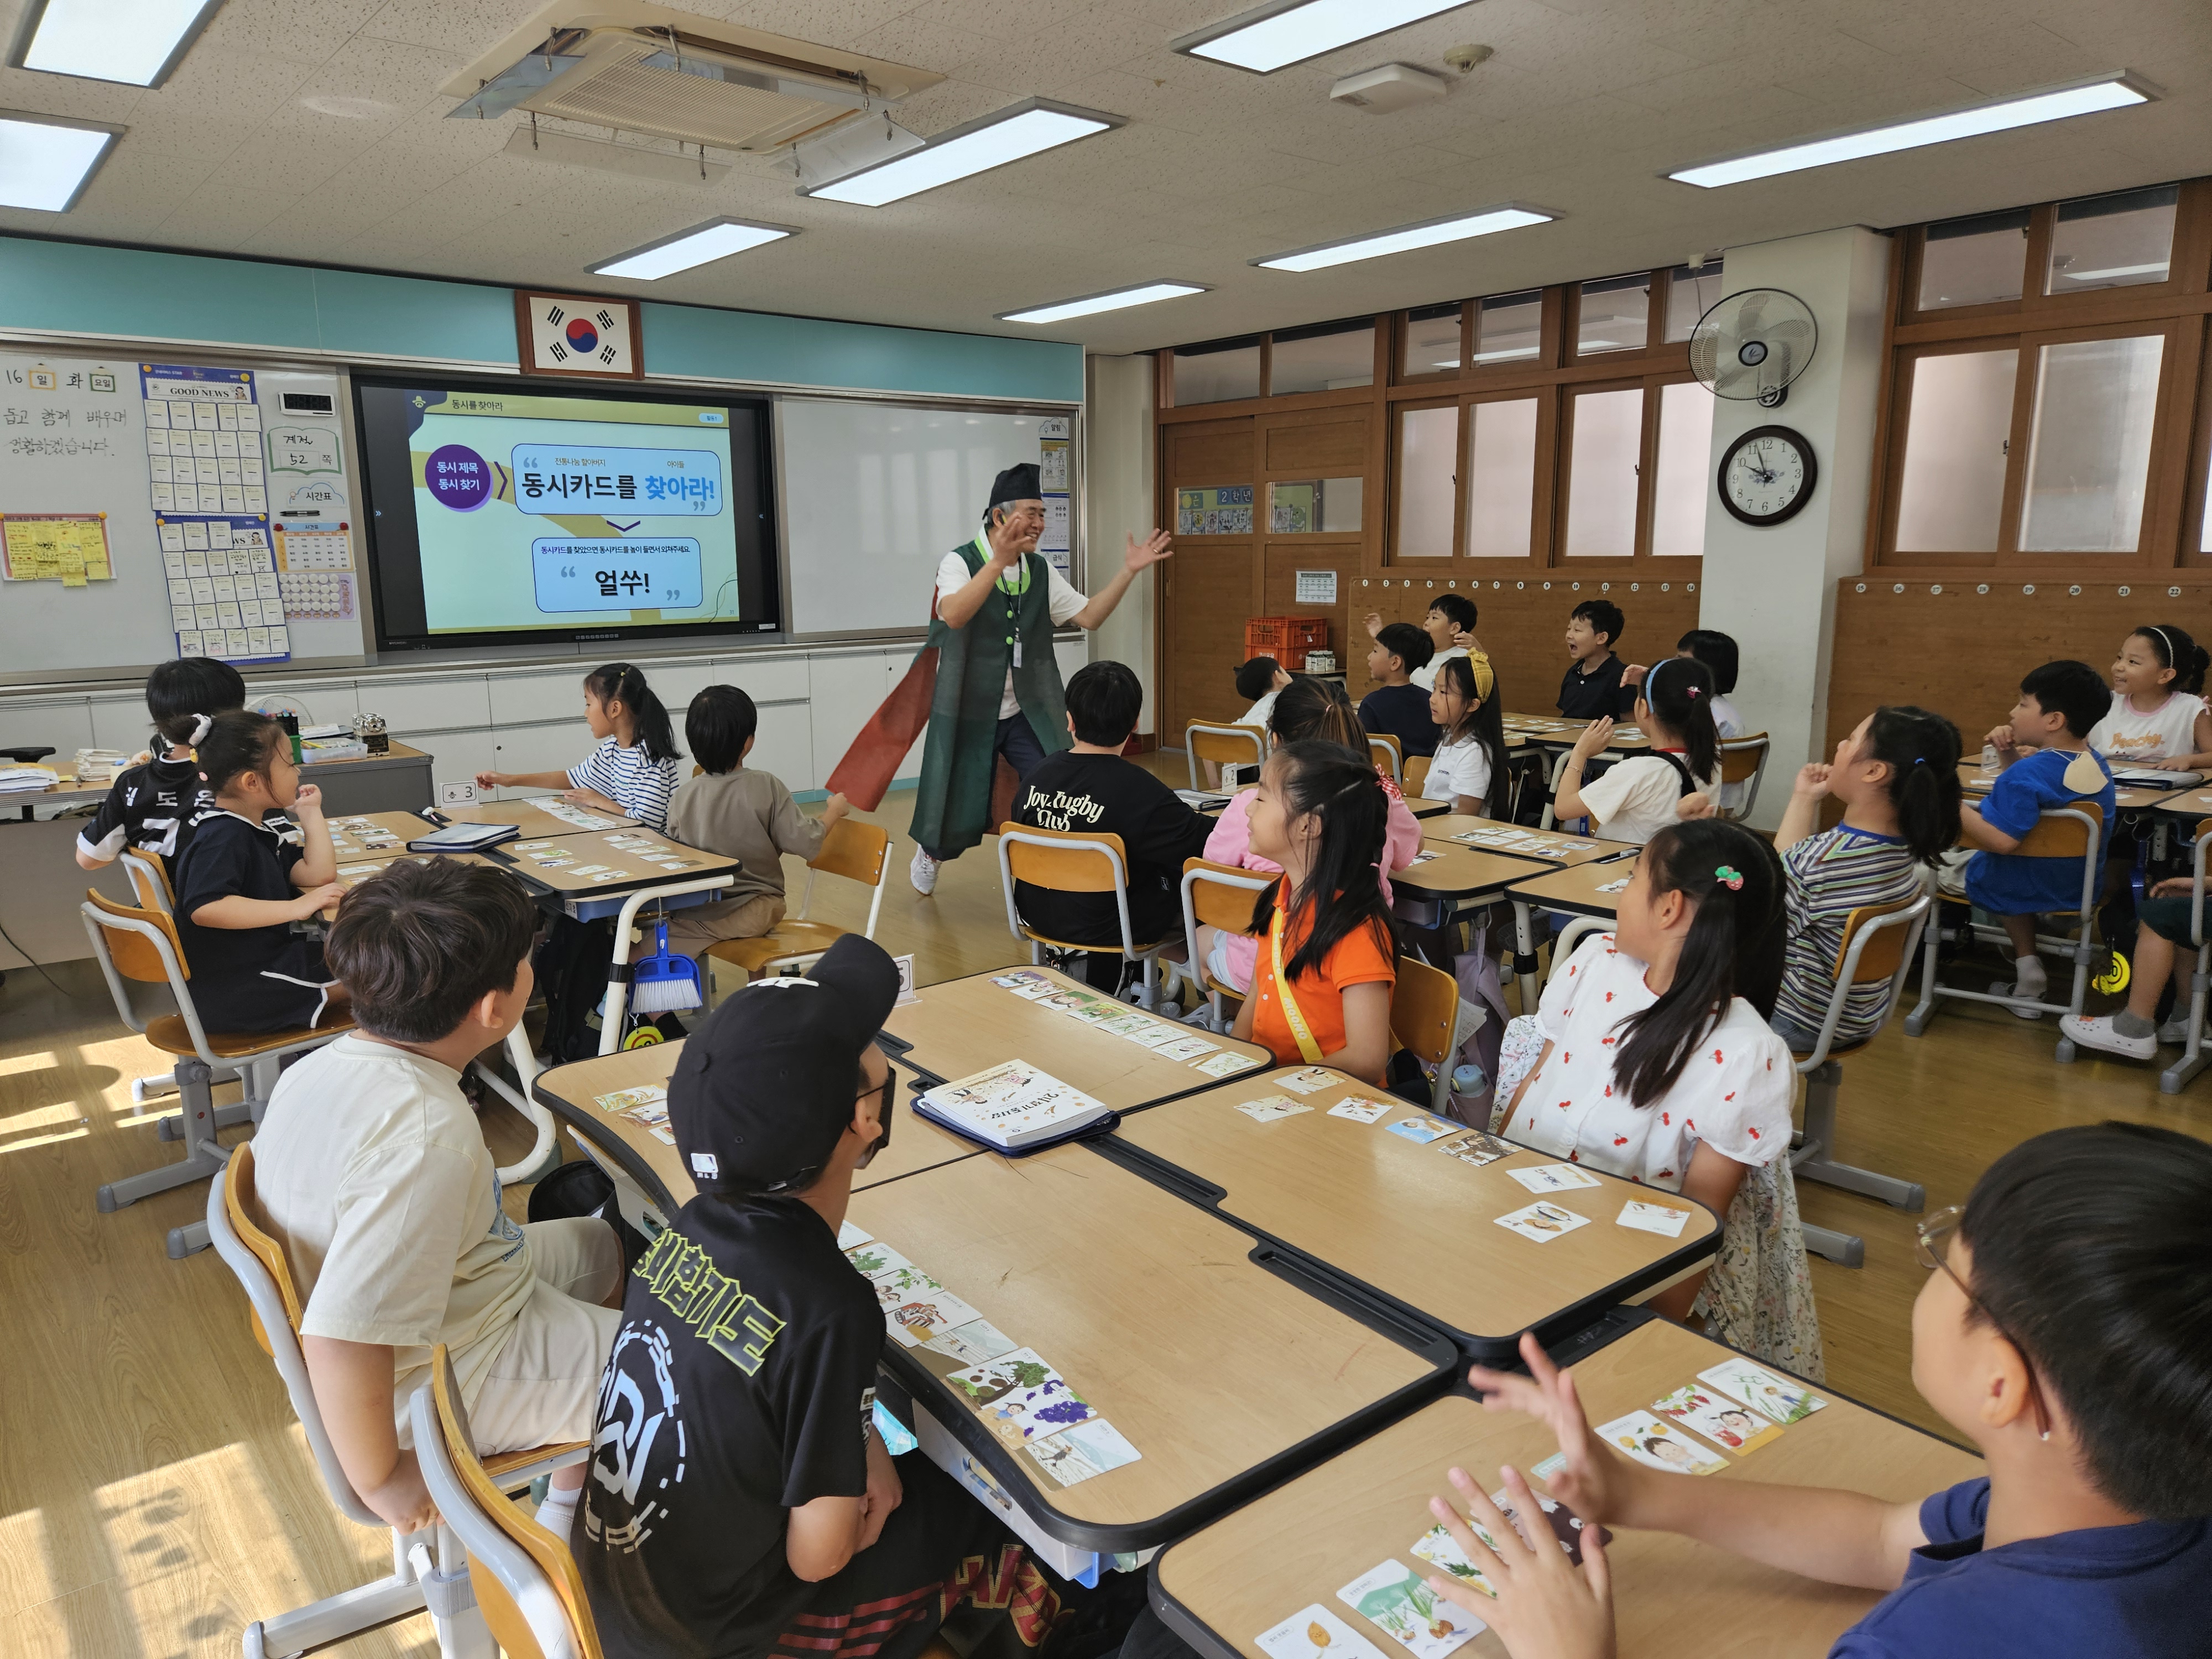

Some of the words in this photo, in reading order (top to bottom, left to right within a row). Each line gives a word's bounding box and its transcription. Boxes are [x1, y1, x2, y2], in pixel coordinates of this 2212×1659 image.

[7, 369, 23, 384] 16
[37, 375, 47, 385] 일
[66, 373, 84, 389] 화
[170, 388, 199, 396] GOOD
[202, 389, 229, 398] NEWS
[452, 400, 477, 410] 동시를
[478, 401, 503, 411] 찾아라
[41, 408, 70, 427] 함께
[87, 409, 127, 428] 배우며
[1748, 445, 1757, 455] 11
[1761, 440, 1773, 450] 12
[1781, 443, 1786, 452] 1
[290, 453, 308, 465] 52
[322, 455, 332, 465] 쪽
[555, 457, 580, 466] 전통나눔
[581, 458, 606, 467] 할아버지
[1736, 458, 1746, 468] 10
[1791, 453, 1797, 463] 2
[437, 462, 457, 473] 동시
[458, 462, 479, 474] 제목
[667, 460, 685, 468] 아이들
[1733, 474, 1739, 483] 9
[1794, 469, 1801, 478] 3
[439, 479, 458, 491] 동시
[460, 479, 479, 491] 찾기
[521, 473, 638, 500] 동시카드를
[645, 475, 715, 501] 찾아라!
[1788, 485, 1796, 494] 4
[306, 492, 332, 501] 시간표
[1736, 489, 1743, 498] 8
[1747, 499, 1754, 509] 7
[1762, 502, 1768, 512] 6
[1778, 497, 1785, 507] 5
[541, 546, 573, 555] 동시카드를
[630, 545, 642, 554] 높이
[595, 570, 650, 596] 얼쑤!
[1230, 770, 1234, 781] 2
[465, 786, 473, 798] 3
